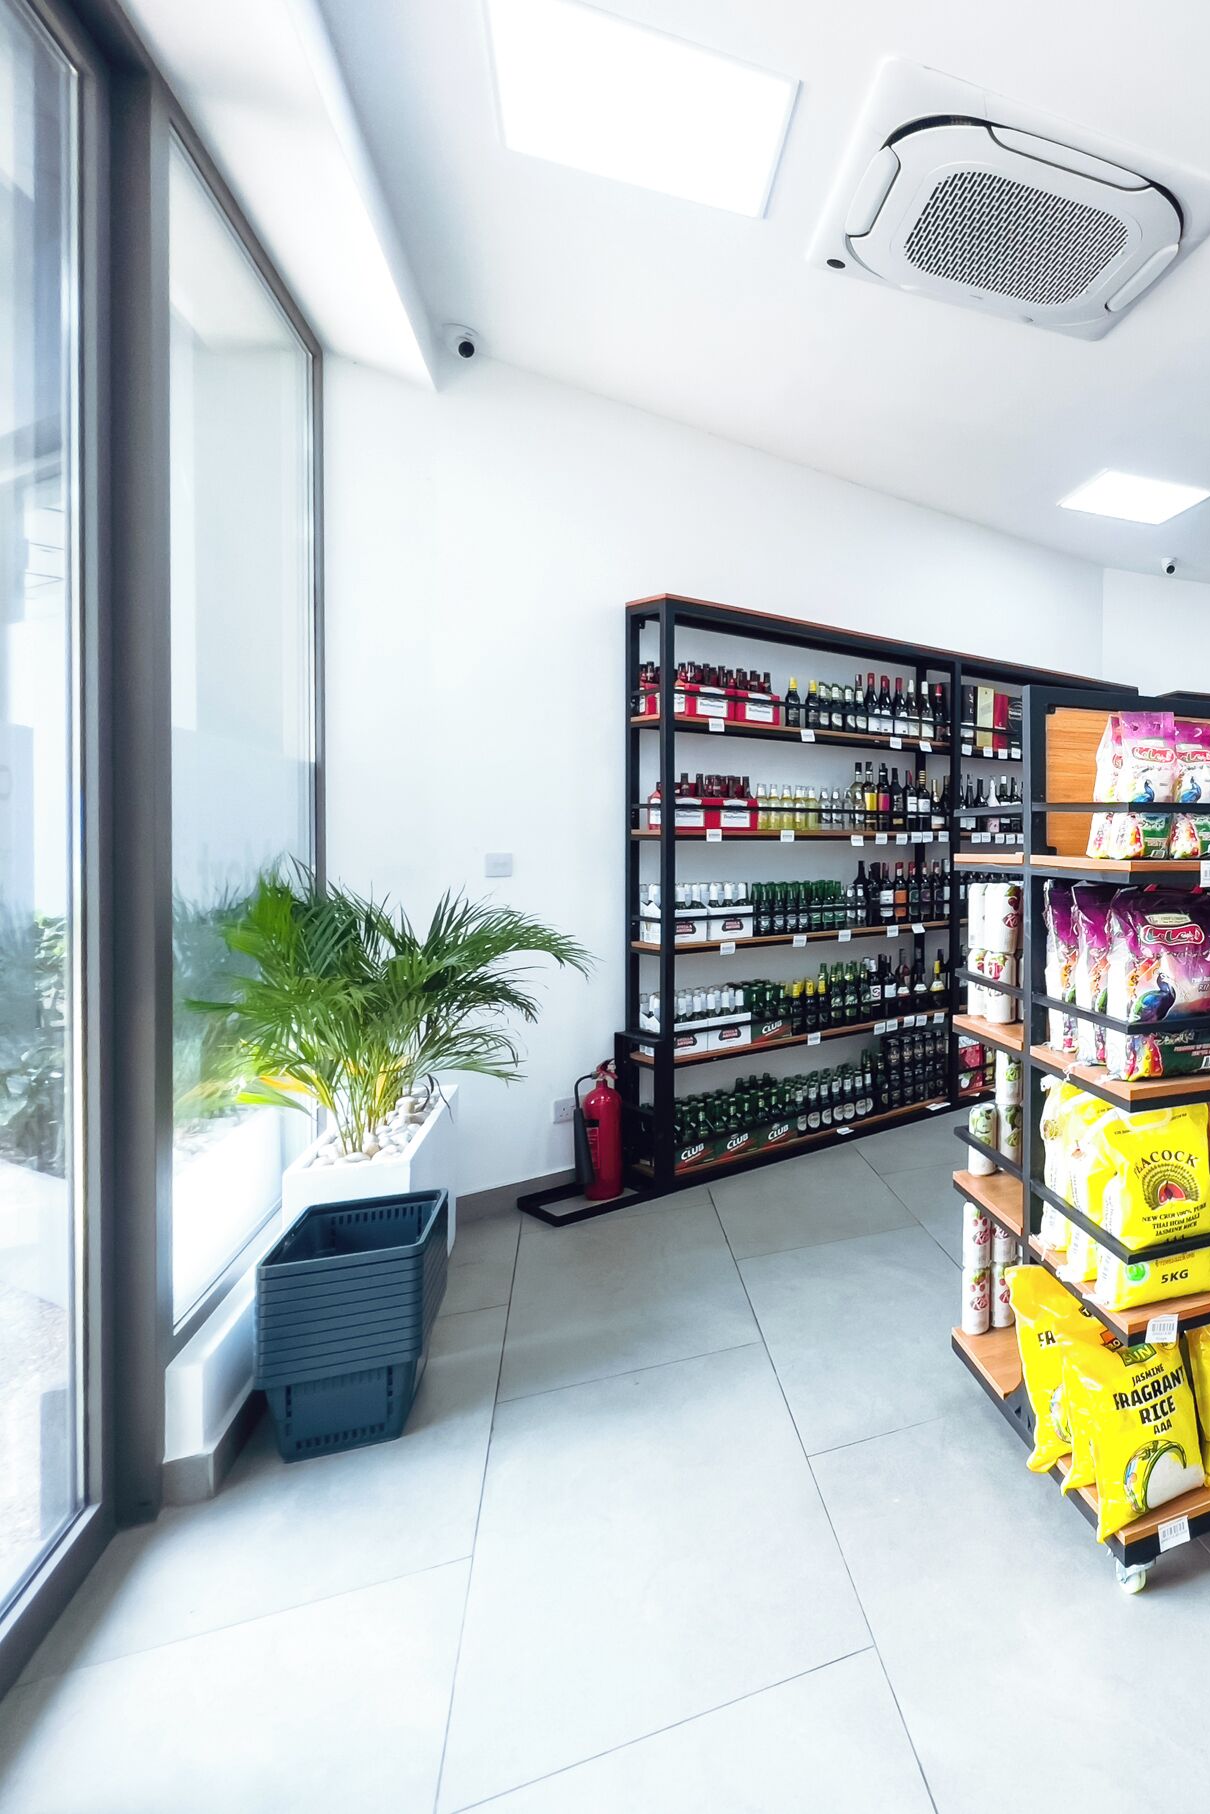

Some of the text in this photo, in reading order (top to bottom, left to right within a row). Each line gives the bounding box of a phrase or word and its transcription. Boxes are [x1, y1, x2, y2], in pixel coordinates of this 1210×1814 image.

[768, 1124, 789, 1140] CLUB
[727, 1133, 749, 1150] CLUB
[681, 1143, 704, 1160] CLUB
[1186, 1213, 1200, 1222] MALI
[1156, 1221, 1197, 1236] JASMINE RICE
[1161, 1269, 1189, 1284] 5KG
[1122, 1345, 1152, 1363] SUN
[1132, 1363, 1165, 1386] JASMINE
[1113, 1366, 1185, 1410] FRAGRANT
[1139, 1395, 1176, 1424] RICE
[1153, 1419, 1173, 1435] AAA
